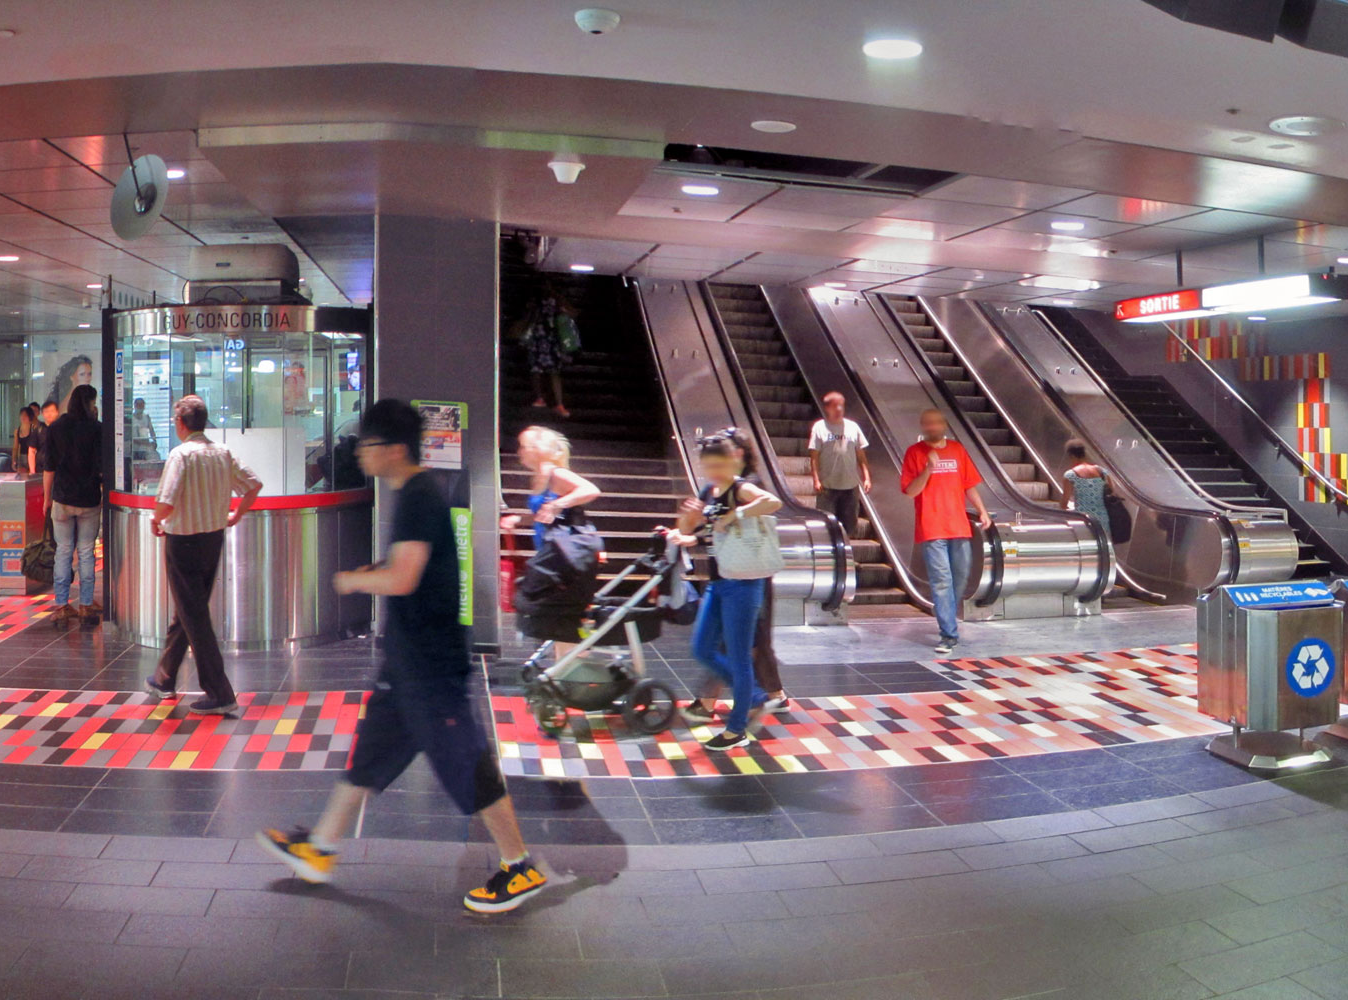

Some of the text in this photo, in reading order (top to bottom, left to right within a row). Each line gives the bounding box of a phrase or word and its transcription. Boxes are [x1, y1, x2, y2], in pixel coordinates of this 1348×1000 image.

[1139, 294, 1180, 314] SORTIE
[164, 312, 291, 330] GUY-CONCORDIA
[455, 514, 468, 560] metro
